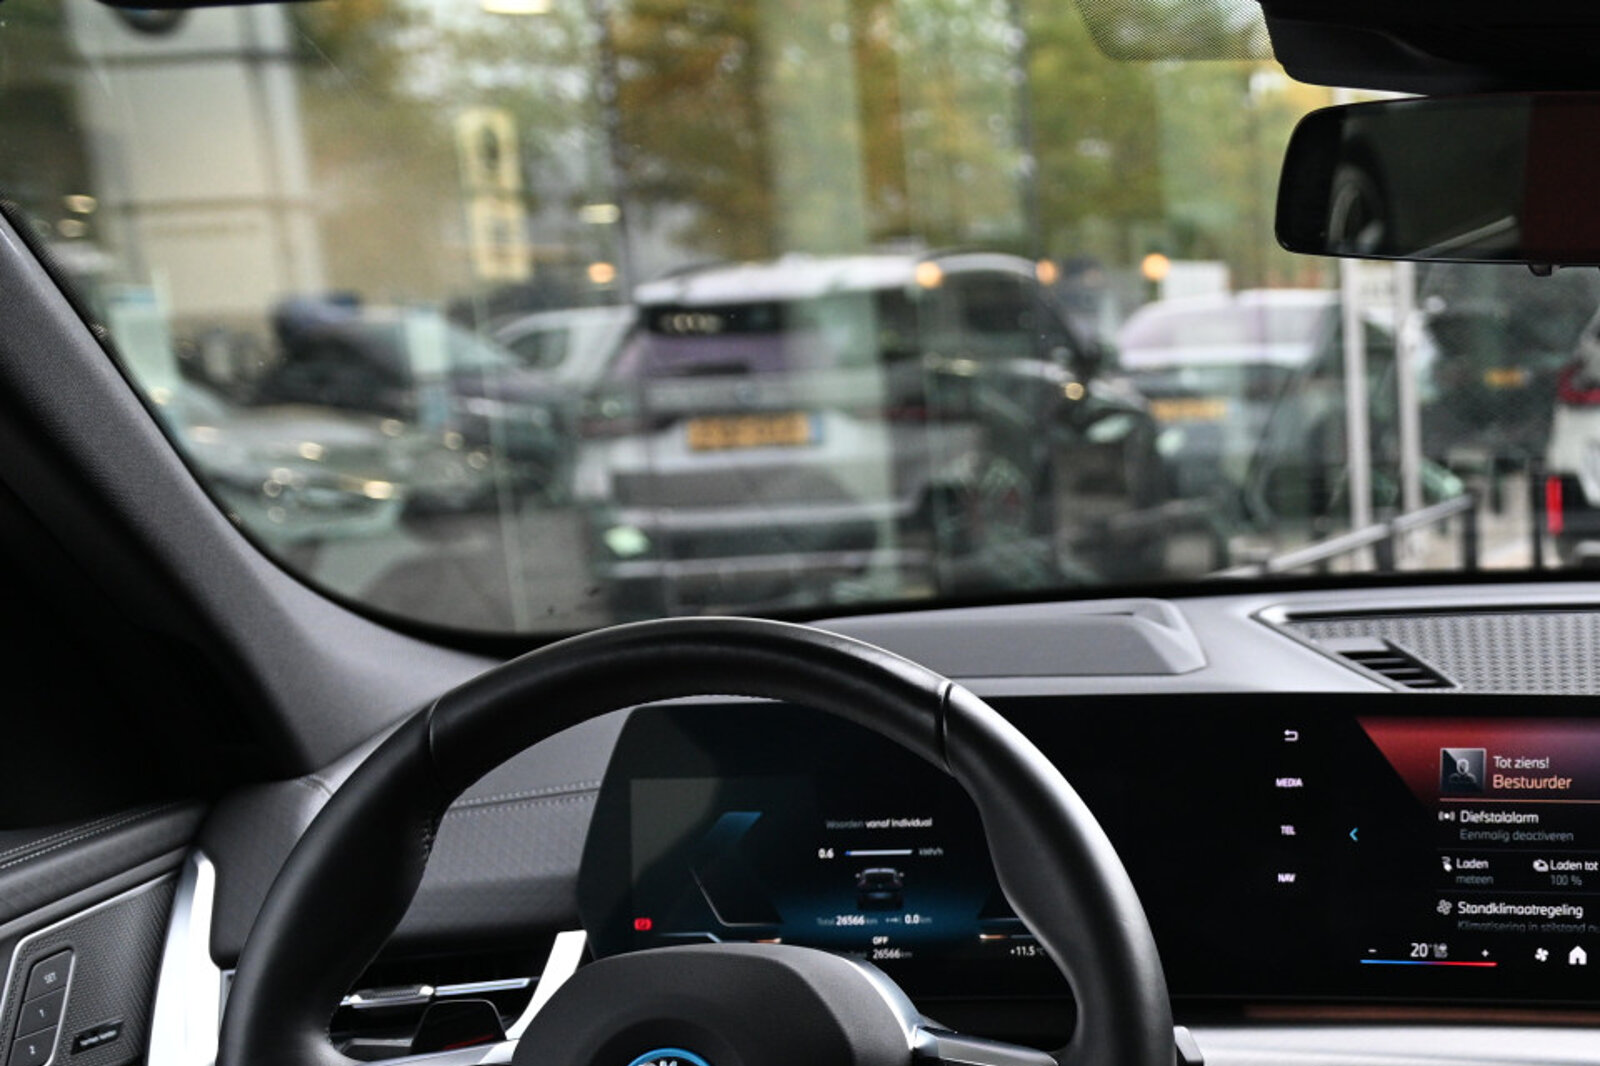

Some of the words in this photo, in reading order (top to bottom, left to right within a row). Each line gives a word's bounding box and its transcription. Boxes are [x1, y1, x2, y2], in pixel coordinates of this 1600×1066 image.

[1493, 756, 1511, 769] Tot
[1514, 756, 1550, 769] ziens!
[1492, 774, 1573, 789] Bestuurder
[1459, 809, 1540, 823] Diefstalalarm
[1459, 829, 1511, 843] Eenmalig
[1512, 829, 1574, 841] deactiveren
[817, 847, 834, 859] 0.6
[1456, 858, 1489, 869] Laden
[1550, 859, 1584, 871] Laden
[1585, 860, 1599, 871] tot
[1551, 874, 1569, 885] 100
[1571, 874, 1583, 886] %
[1457, 901, 1584, 919] Standklimaatregeling
[836, 915, 865, 926] 26566
[904, 914, 920, 924] 0.0
[872, 936, 889, 946] OFF
[872, 948, 901, 960] 26566
